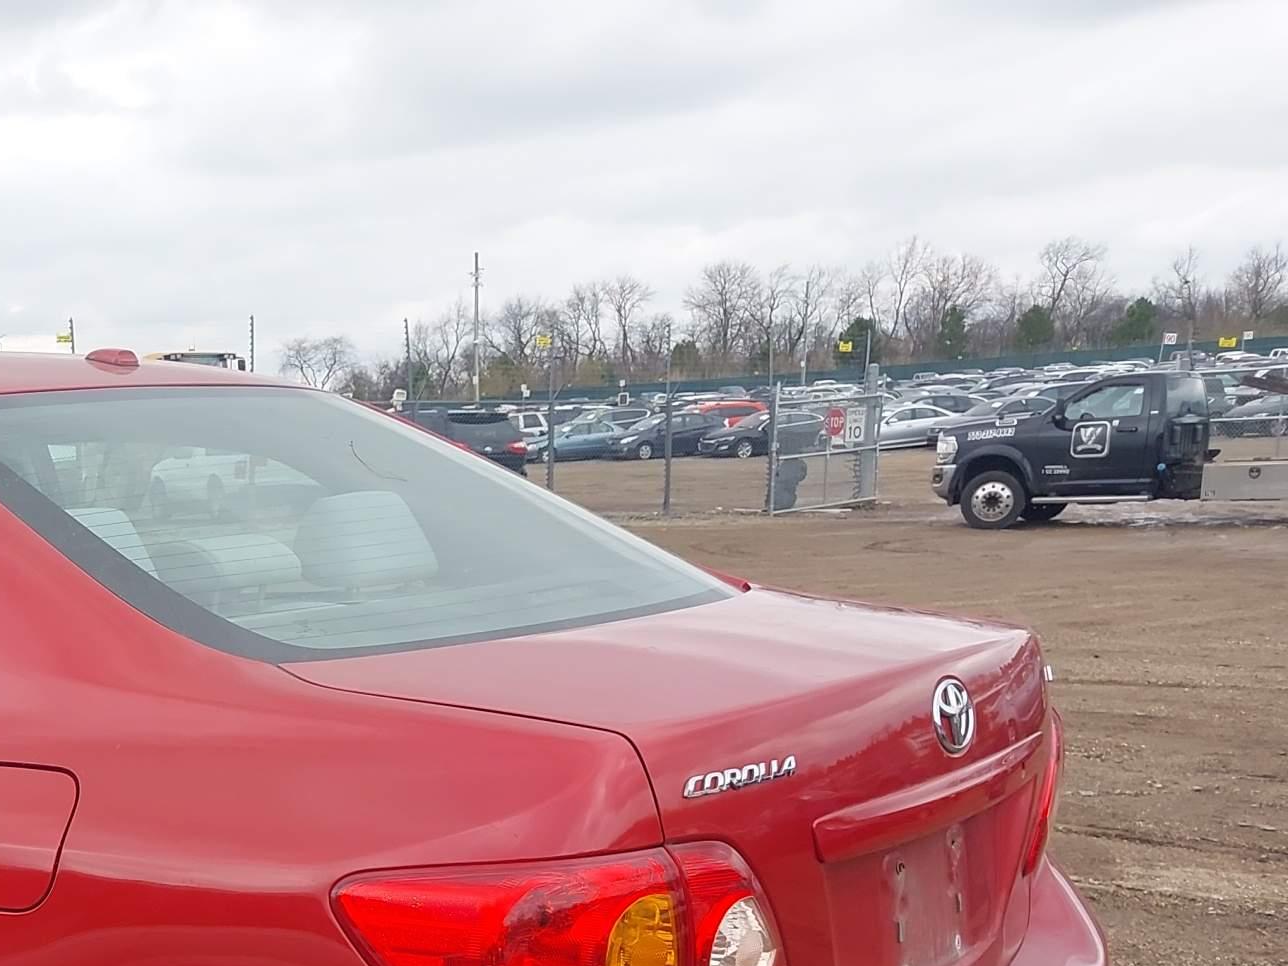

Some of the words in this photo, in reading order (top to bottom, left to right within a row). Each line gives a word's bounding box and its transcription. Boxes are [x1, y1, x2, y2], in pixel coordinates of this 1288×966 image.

[824, 415, 844, 430] STOP
[848, 425, 862, 439] 10
[683, 755, 797, 798] COROLLA
